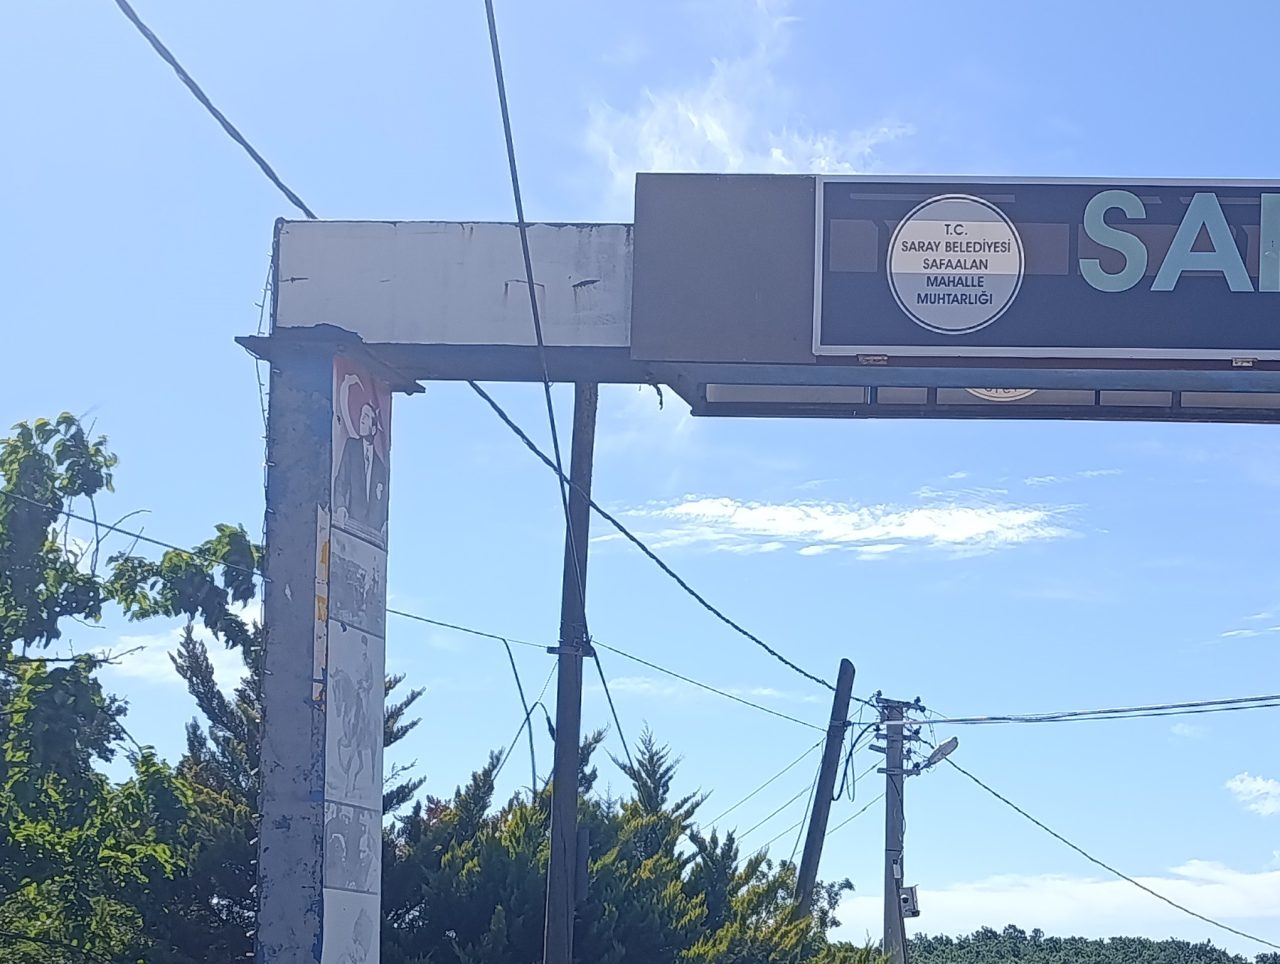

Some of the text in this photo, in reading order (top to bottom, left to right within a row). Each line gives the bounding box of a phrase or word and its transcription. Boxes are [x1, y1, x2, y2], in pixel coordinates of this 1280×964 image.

[944, 223, 968, 236] T.C.
[901, 238, 1011, 253] SARAY BELEDİYESİ
[922, 258, 988, 270] SAFAALAN
[926, 275, 984, 288] MAHALLE
[916, 290, 993, 305] MUHTARLIĞI
